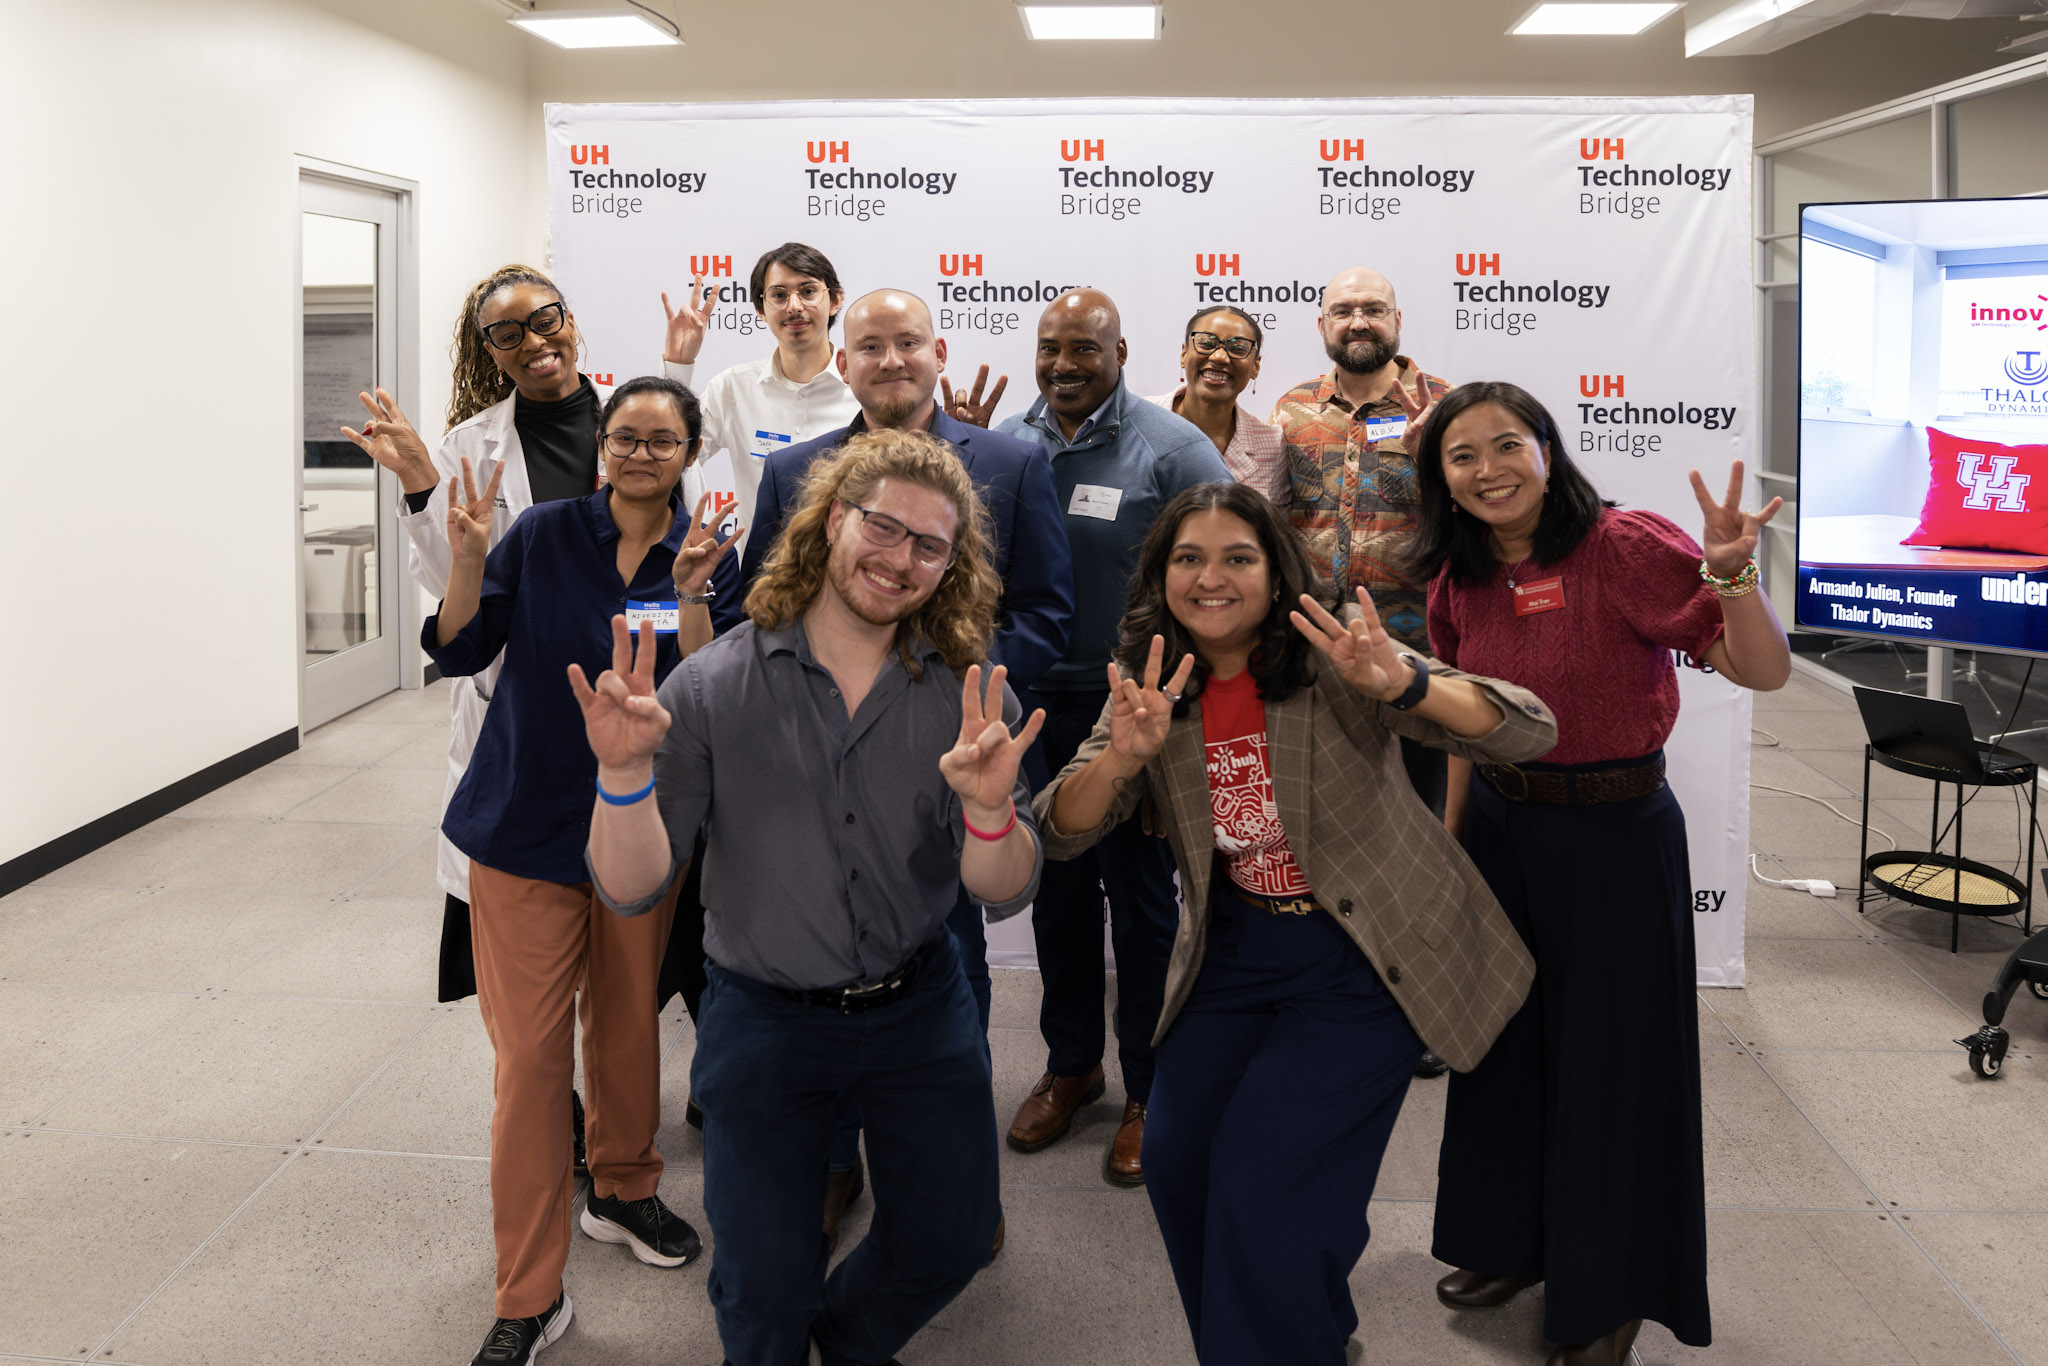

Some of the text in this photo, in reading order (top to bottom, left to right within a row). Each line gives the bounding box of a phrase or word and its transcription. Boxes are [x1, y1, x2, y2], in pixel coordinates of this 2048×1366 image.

[571, 145, 609, 165] UH
[807, 141, 849, 163] UH
[1061, 139, 1104, 161] UH
[1320, 139, 1364, 161] UH
[1580, 138, 1624, 160] UH
[569, 168, 706, 193] Technology
[805, 167, 957, 194] Technology
[1059, 165, 1214, 193] Technology
[1318, 165, 1475, 193] Technology
[1578, 164, 1731, 191] Technology
[573, 193, 643, 218] Bridge
[808, 194, 885, 221] Bridge
[1062, 192, 1141, 220] Bridge
[1320, 192, 1401, 220] Bridge
[1580, 191, 1660, 219] Bridge
[690, 255, 732, 277] UH
[940, 254, 982, 276] UH
[1196, 254, 1239, 276] UH
[1456, 253, 1500, 276] UH
[938, 280, 1092, 302] Technolo
[1454, 280, 1610, 308] Technology
[697, 307, 767, 335] ridge
[940, 308, 1019, 335] Bridge
[1456, 307, 1536, 336] Bridge
[1580, 375, 1624, 398] UH
[1578, 402, 1736, 430] Technology
[1371, 426, 1394, 436] ALEX
[1580, 429, 1661, 453] Bridge
[1809, 577, 1958, 608] Armando Julien, Founder
[1831, 603, 1933, 630] Thalor Dynamics
